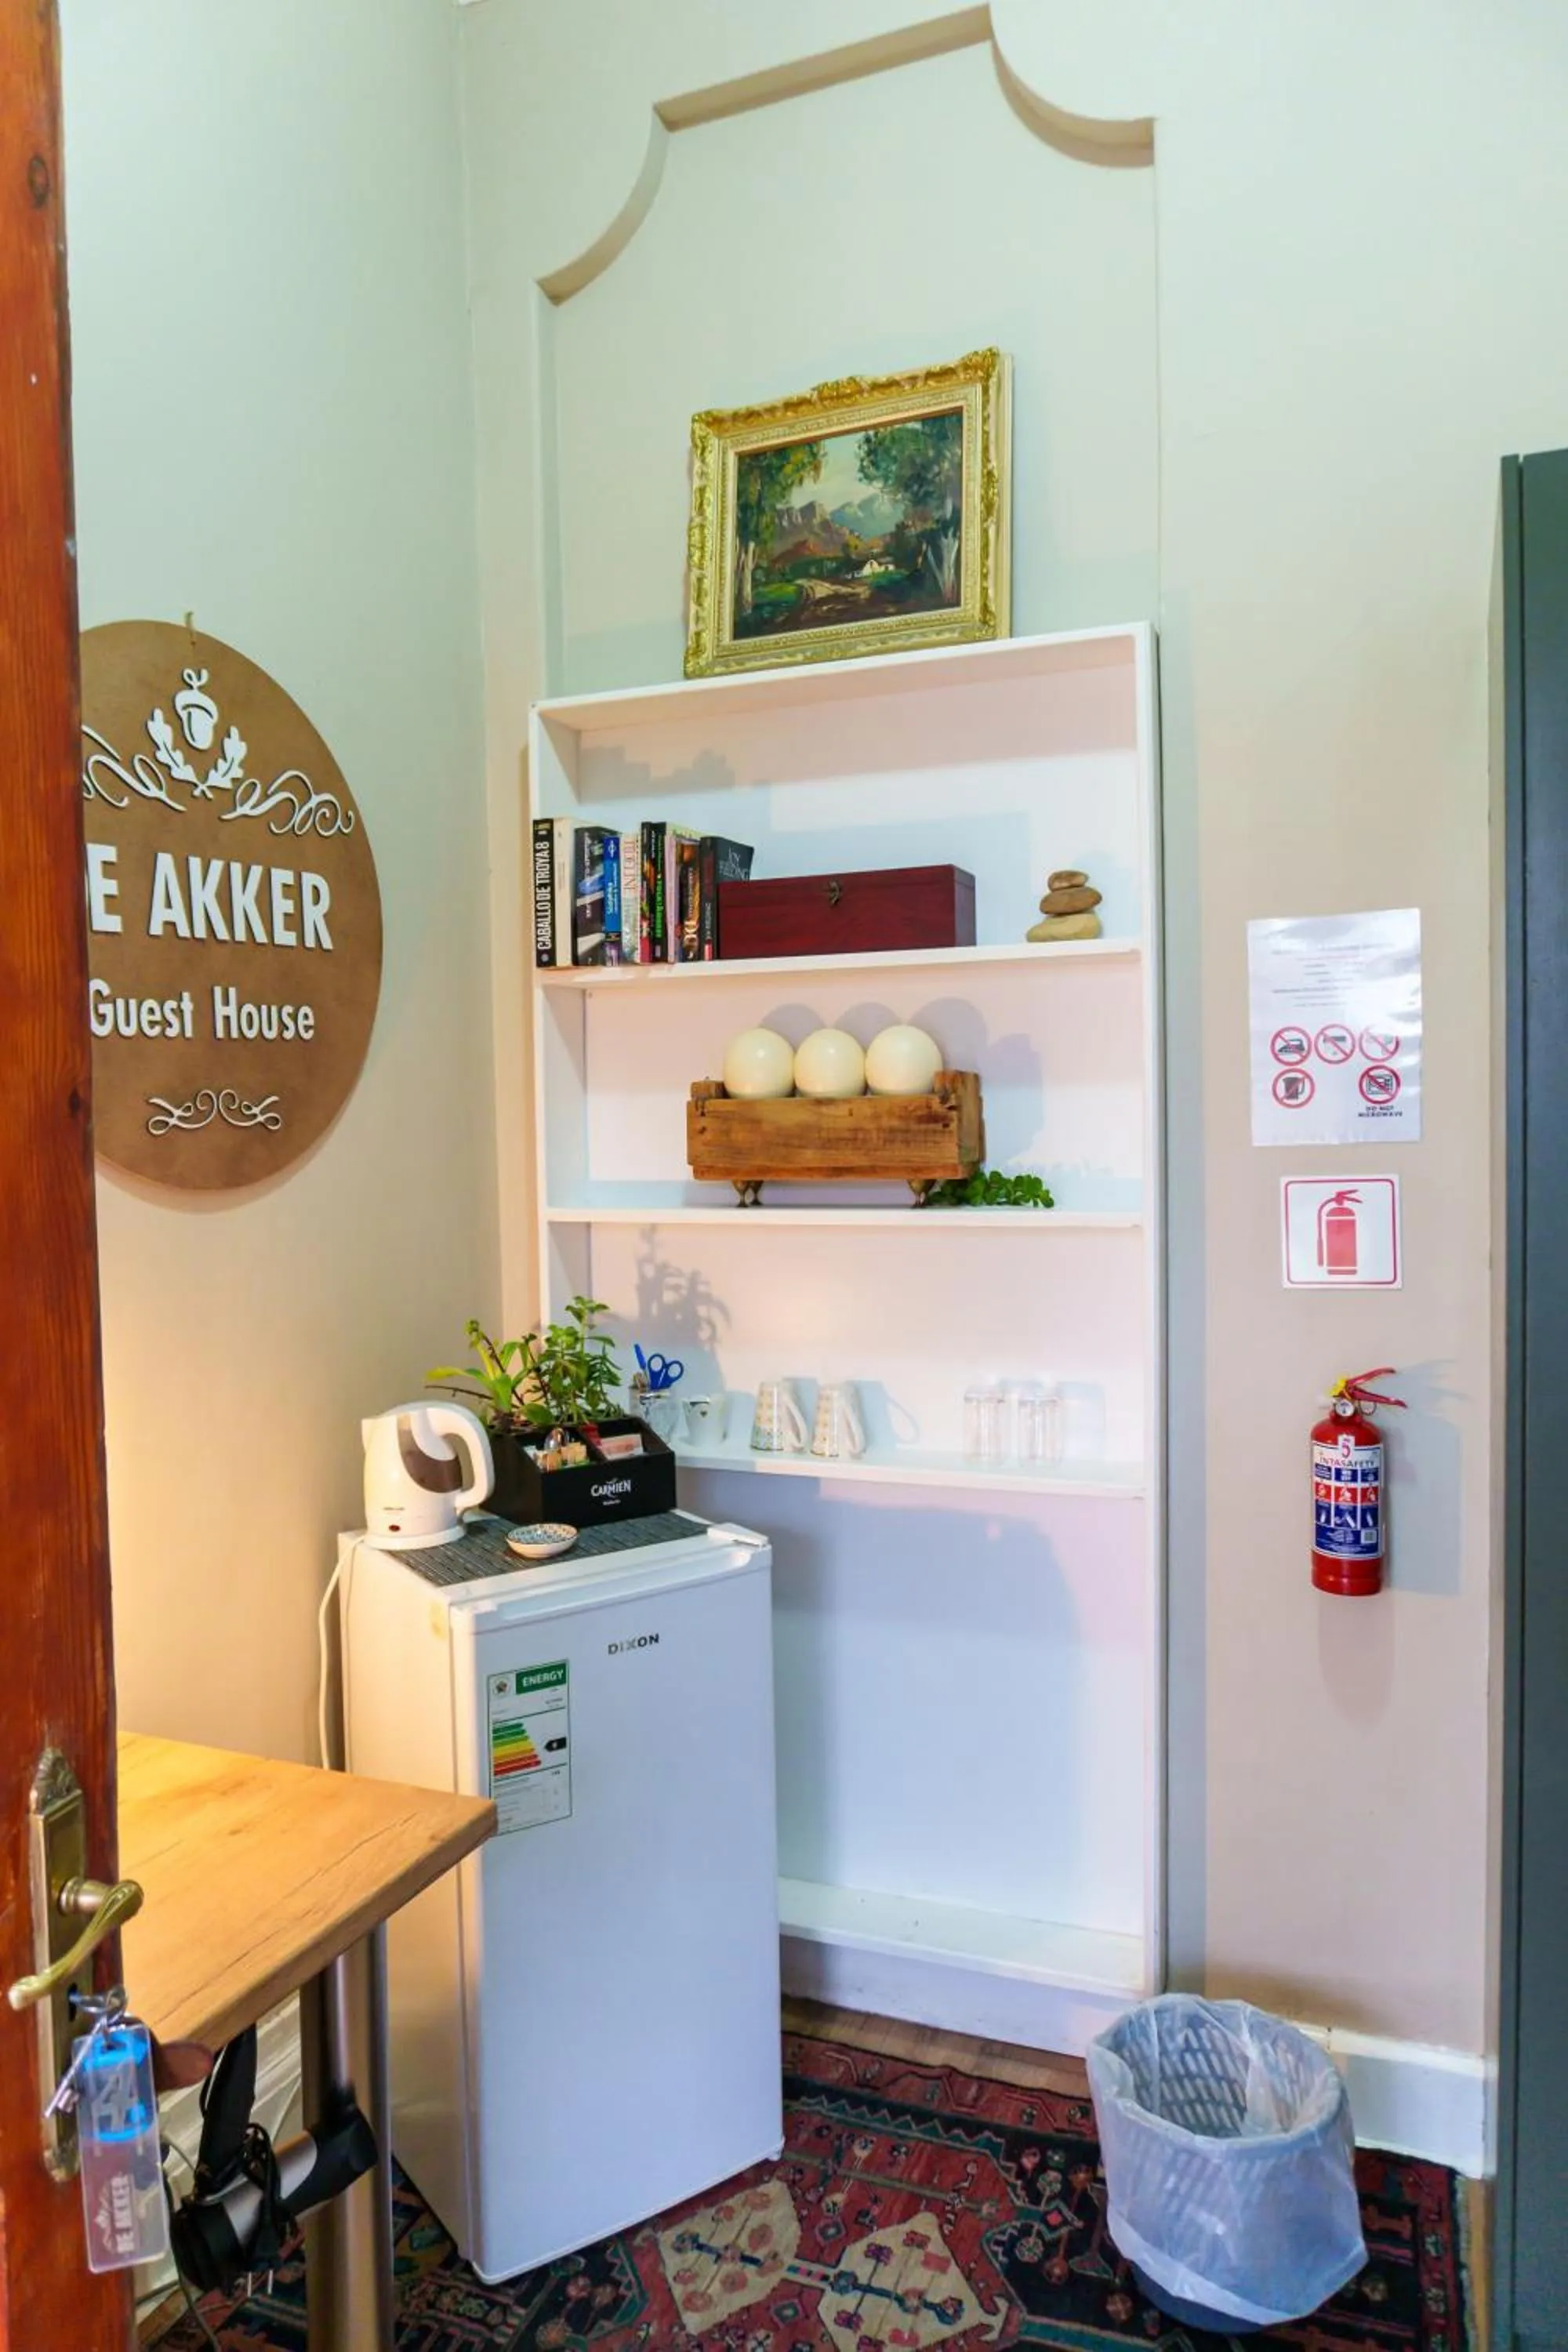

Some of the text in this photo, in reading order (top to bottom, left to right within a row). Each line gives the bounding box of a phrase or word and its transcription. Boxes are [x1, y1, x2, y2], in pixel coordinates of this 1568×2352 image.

[535, 849, 551, 885] TROYA
[83, 842, 334, 950] E AKKER
[535, 886, 552, 901] DE
[536, 902, 553, 950] CABALLO
[89, 978, 315, 1041] Guest House
[607, 1633, 660, 1655] DIXON
[521, 1669, 564, 1688] ENERGY
